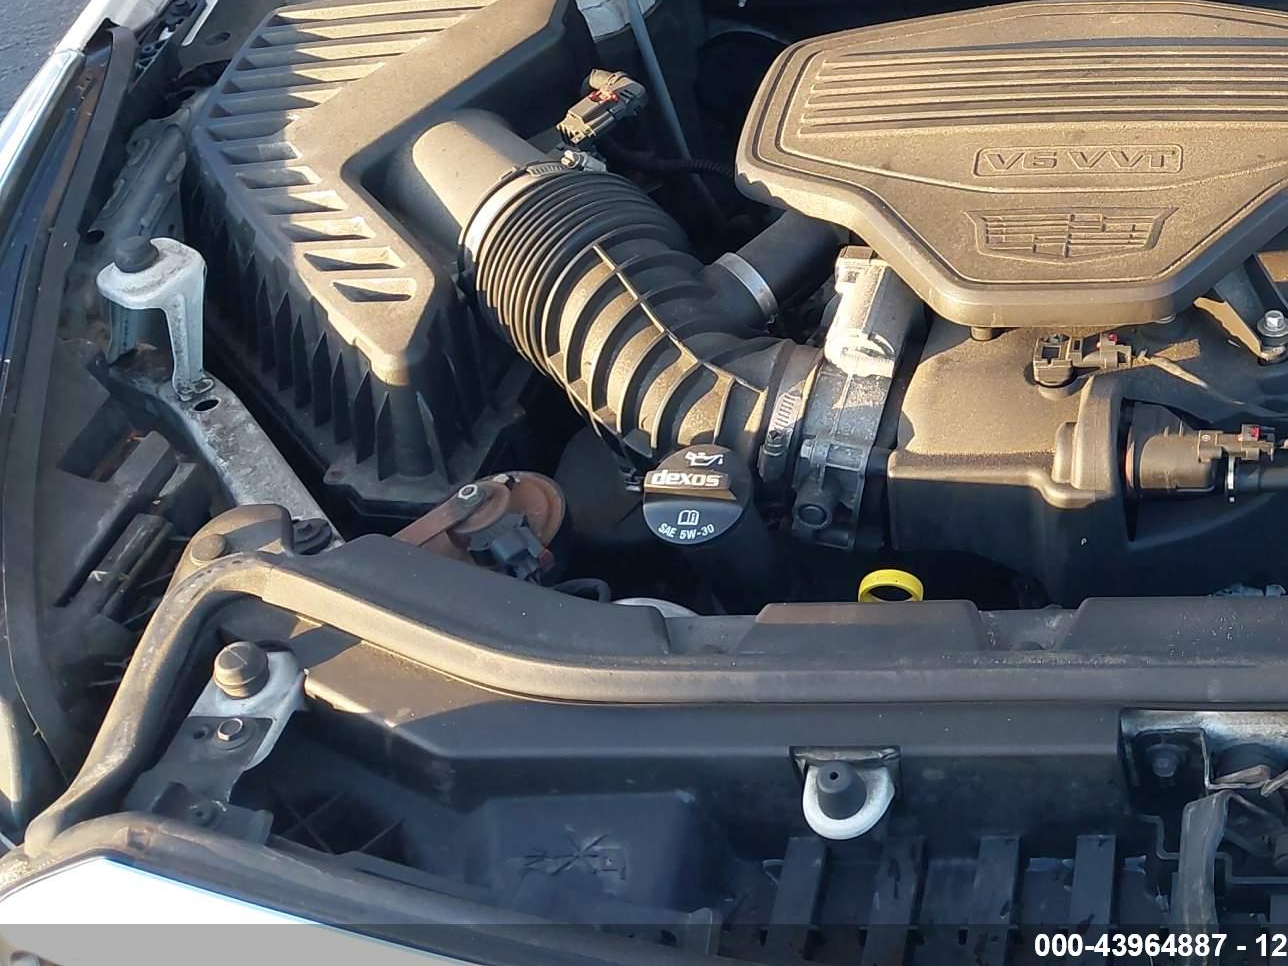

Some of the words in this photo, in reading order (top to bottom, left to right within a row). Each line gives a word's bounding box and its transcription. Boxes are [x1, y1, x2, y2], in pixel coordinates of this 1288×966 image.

[985, 151, 1057, 171] V6
[1069, 150, 1175, 170] VVT
[651, 469, 722, 487] dexos
[658, 523, 676, 538] SAE
[679, 524, 714, 540] 5W-30
